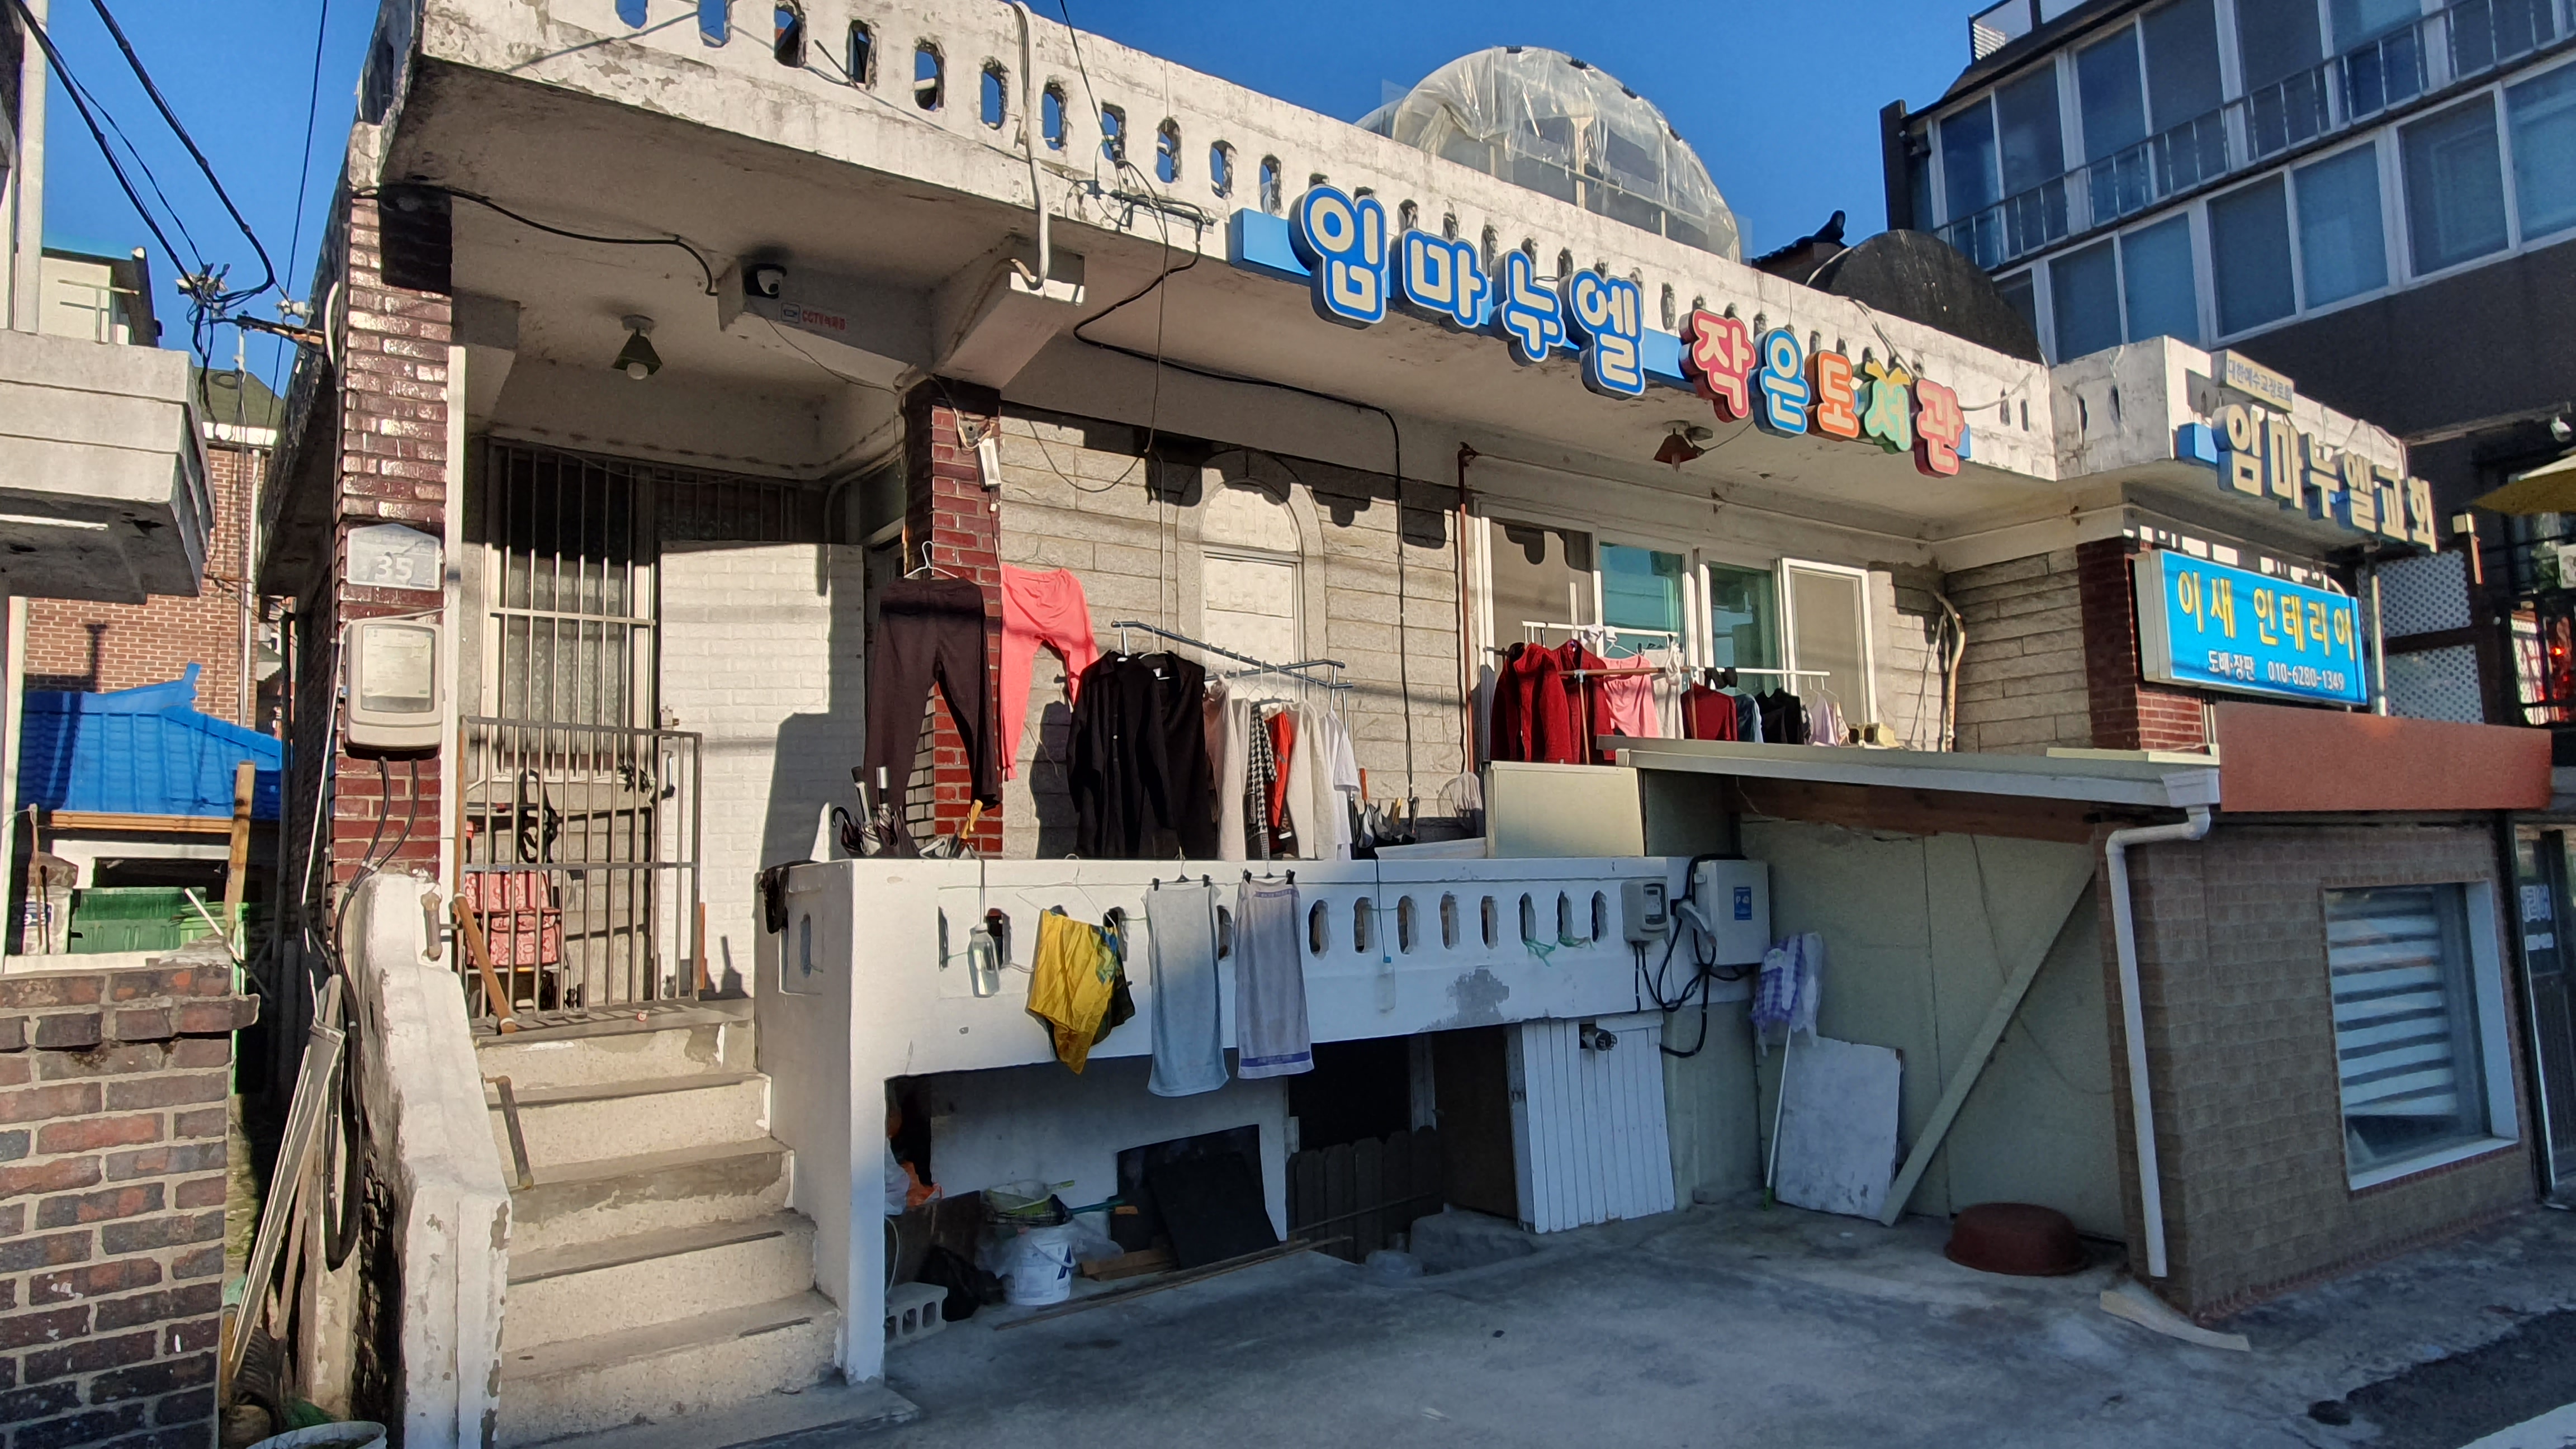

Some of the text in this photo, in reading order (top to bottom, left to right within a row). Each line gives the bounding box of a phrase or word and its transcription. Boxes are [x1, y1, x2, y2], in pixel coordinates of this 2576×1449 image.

[1301, 185, 1645, 395] 임마누엘
[2228, 359, 2292, 402] 대한예수교장로회
[2225, 404, 2437, 553] 임마누엘교회
[375, 556, 414, 581] 35
[2178, 571, 2355, 661] 이새 인테리어
[2267, 661, 2345, 690] 010-6280-1349
